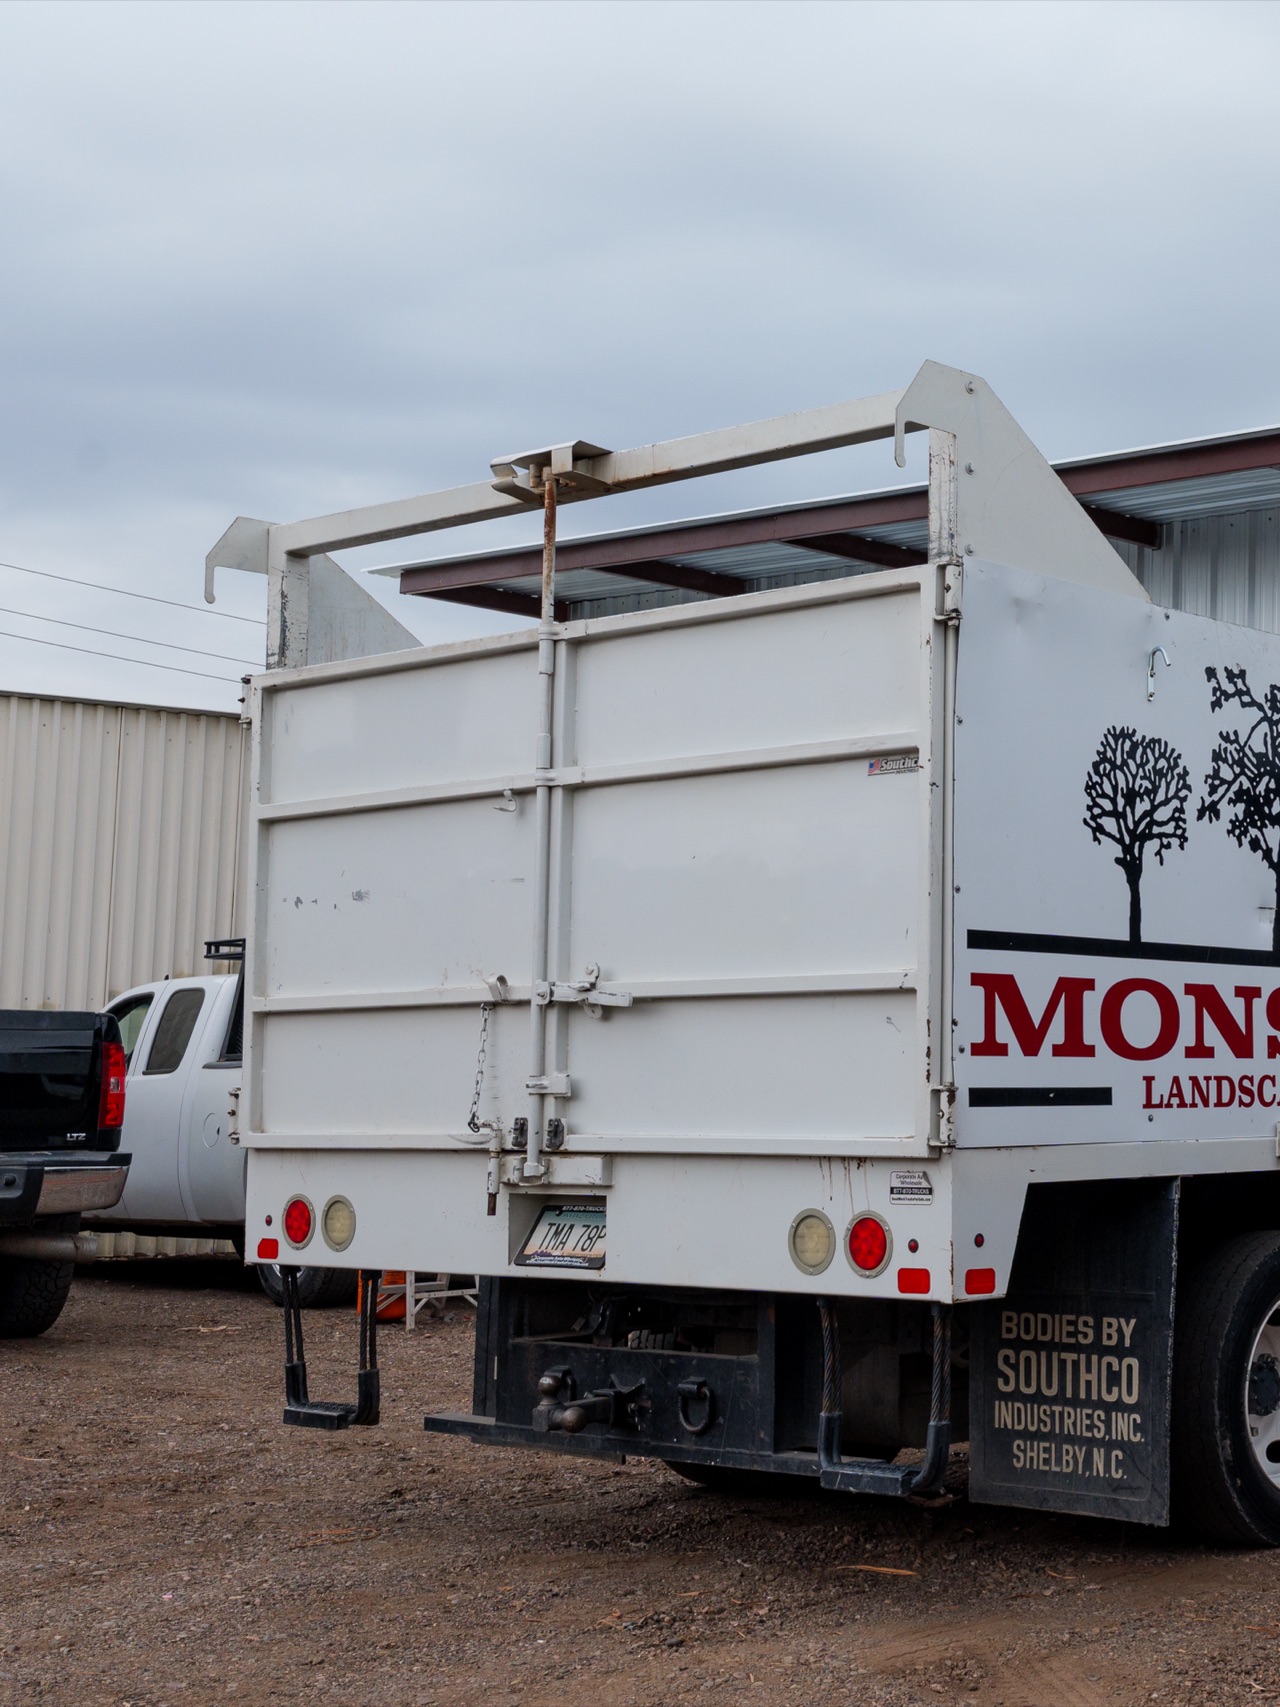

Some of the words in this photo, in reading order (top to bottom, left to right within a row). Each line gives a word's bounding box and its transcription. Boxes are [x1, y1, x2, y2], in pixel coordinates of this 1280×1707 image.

[880, 757, 919, 771] Southc
[66, 1133, 86, 1141] LTZ
[538, 1222, 576, 1251] TMA
[1001, 1310, 1094, 1345] BODIES
[1102, 1317, 1137, 1347] BY
[997, 1349, 1139, 1405] SOUTHCO
